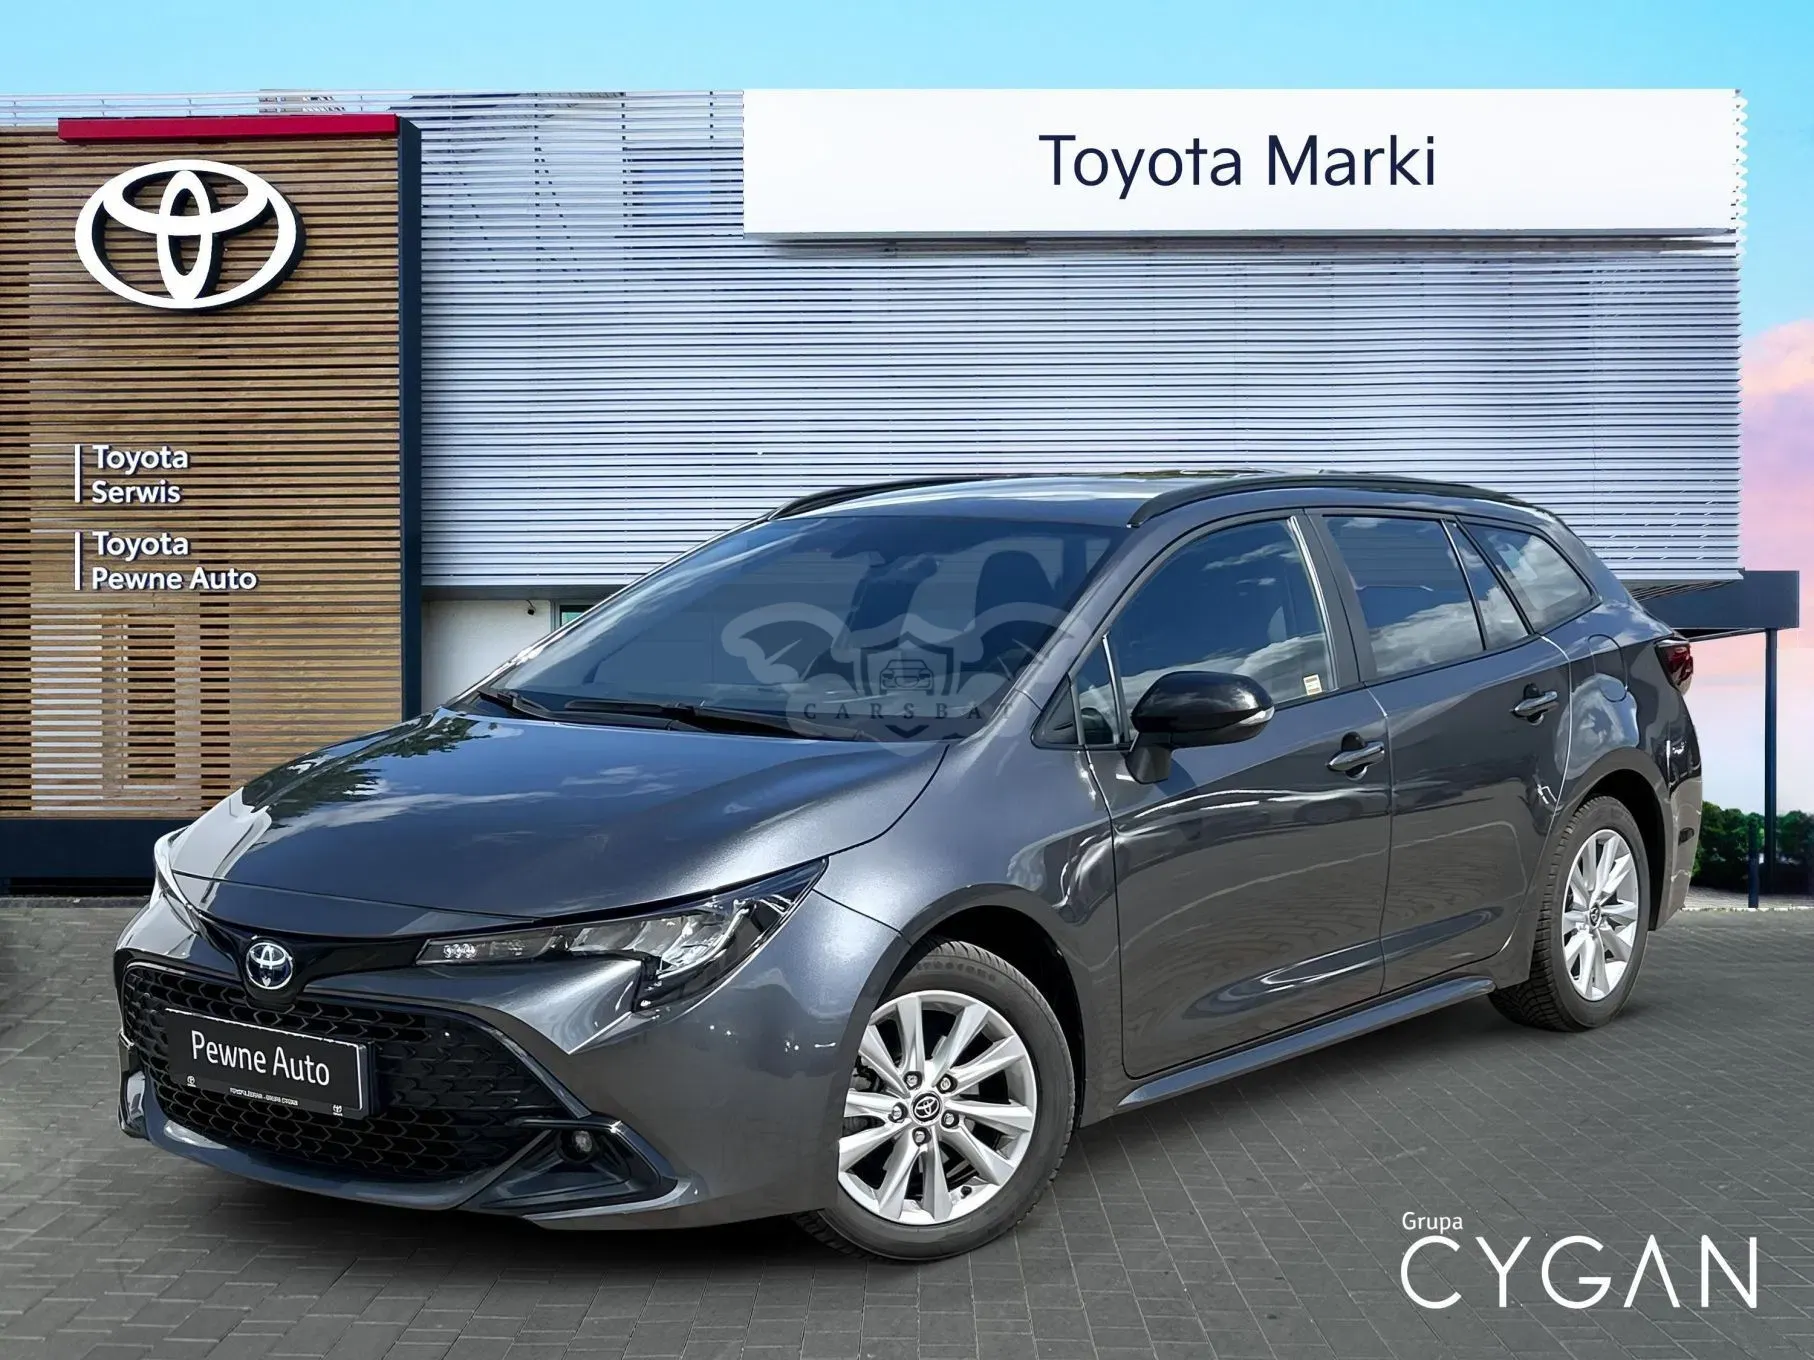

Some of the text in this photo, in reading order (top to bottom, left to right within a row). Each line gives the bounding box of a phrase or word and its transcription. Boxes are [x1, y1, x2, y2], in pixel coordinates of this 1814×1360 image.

[1038, 134, 1435, 200] Toyota Marki
[92, 444, 189, 475] Toyota
[92, 479, 181, 504] Serwis
[92, 531, 189, 562] Toyota
[92, 566, 257, 591] Pewne Auto
[191, 1029, 330, 1086] Pewne Auto
